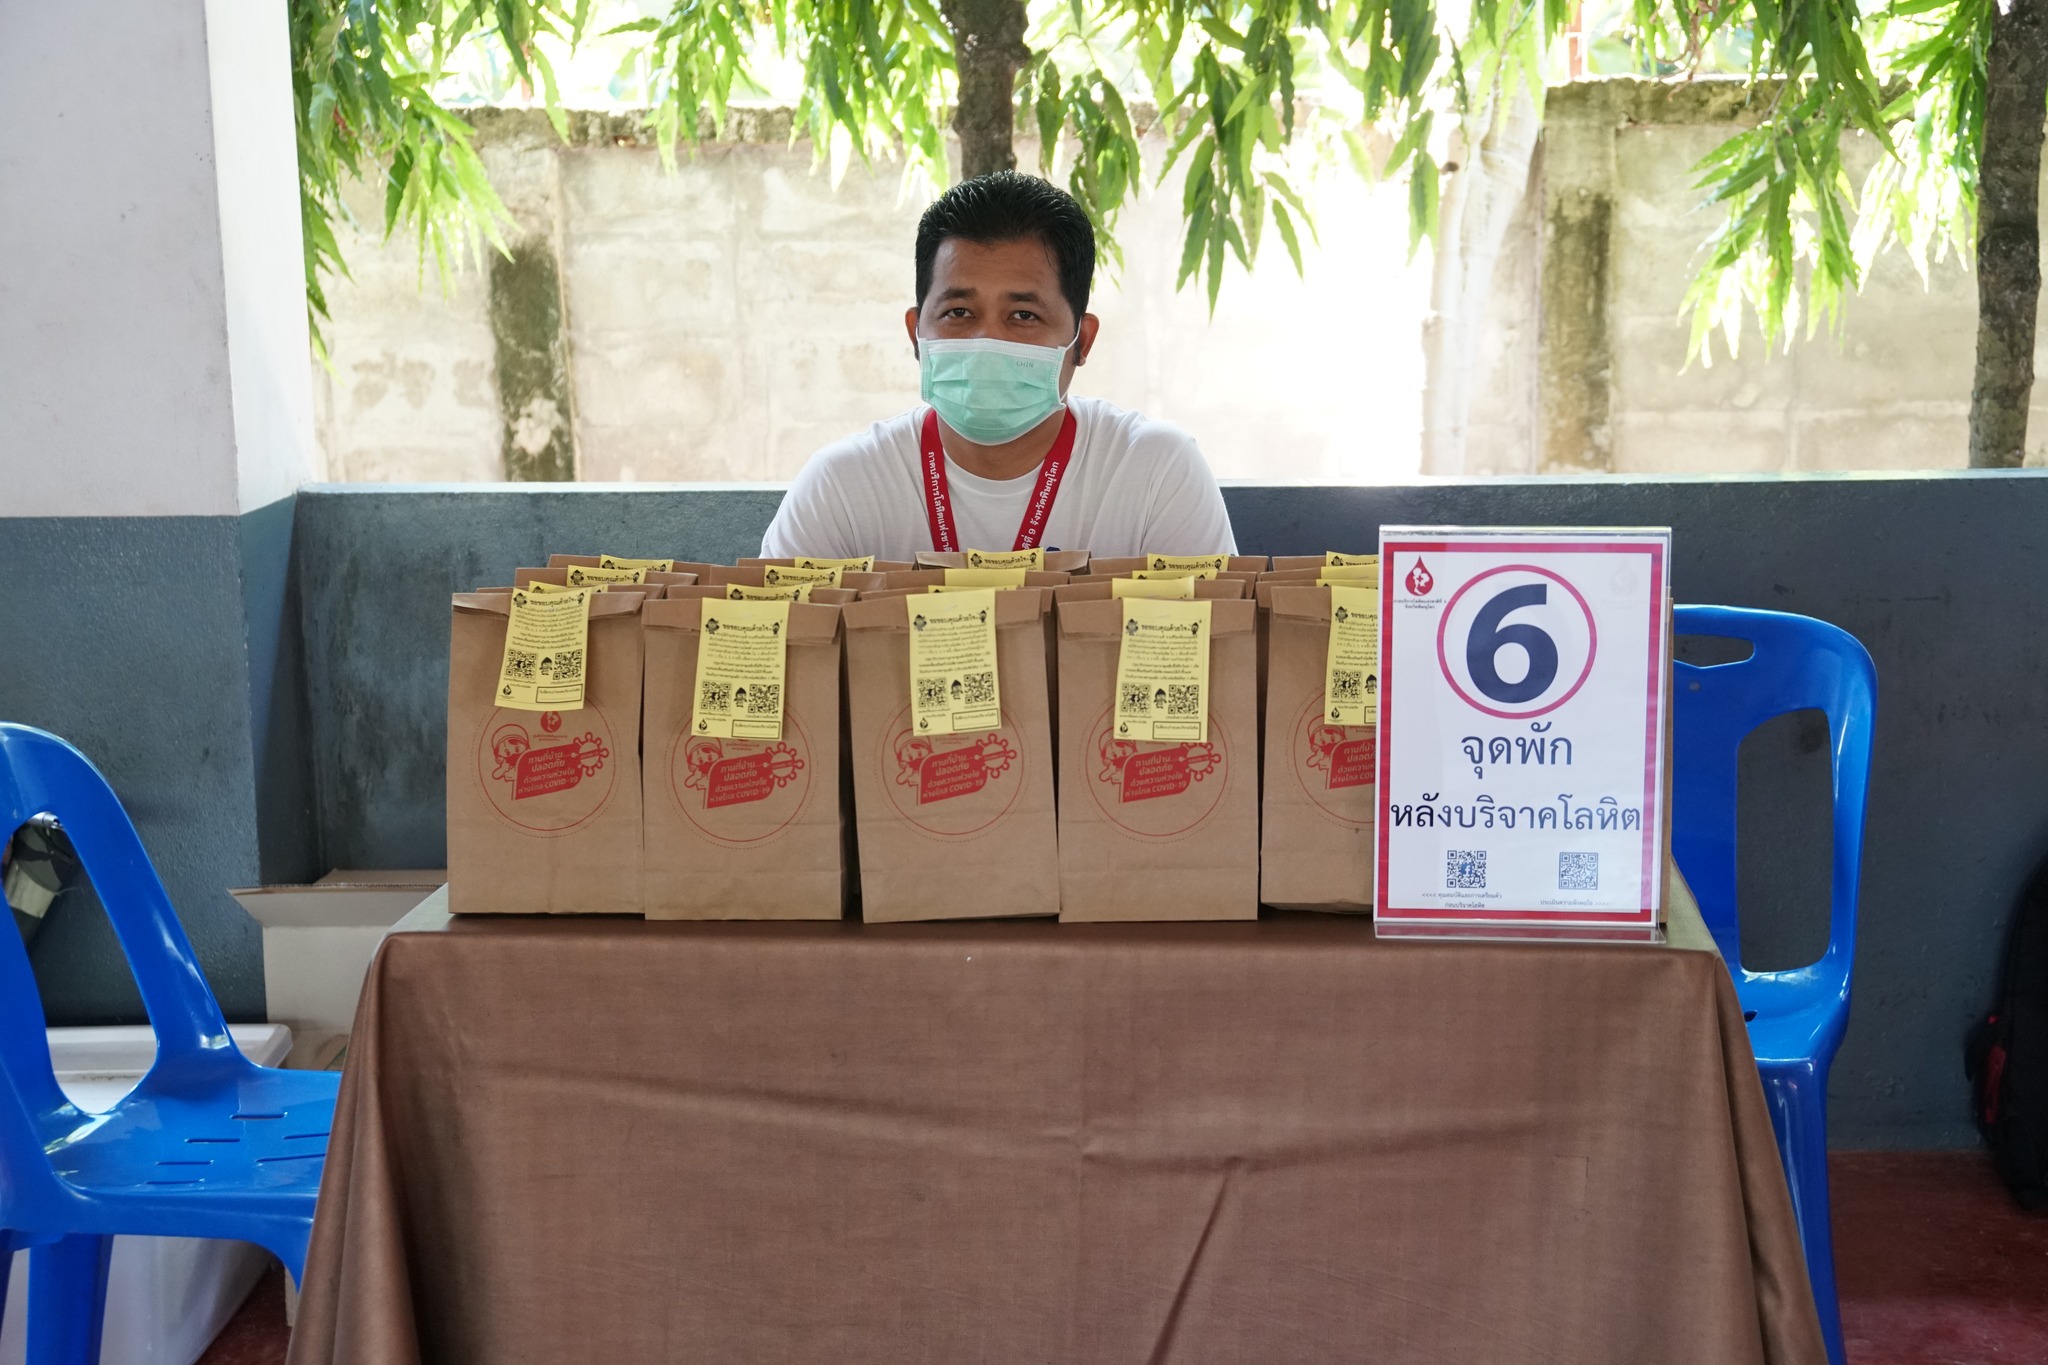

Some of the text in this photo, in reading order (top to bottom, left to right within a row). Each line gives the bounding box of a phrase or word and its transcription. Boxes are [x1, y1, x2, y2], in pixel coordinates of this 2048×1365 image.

[1029, 461, 1060, 526] จังหวัดพิษณุโลก
[1466, 583, 1559, 703] 6
[1461, 721, 1572, 779] จุดพัก
[531, 758, 565, 773] ปลอดภัย
[724, 769, 758, 781] ปลอดภัย
[935, 763, 970, 776] ปลอดภัย
[1139, 763, 1173, 775] ปลอดภัย
[1391, 792, 1641, 831] หลังบริจาคโลหิต
